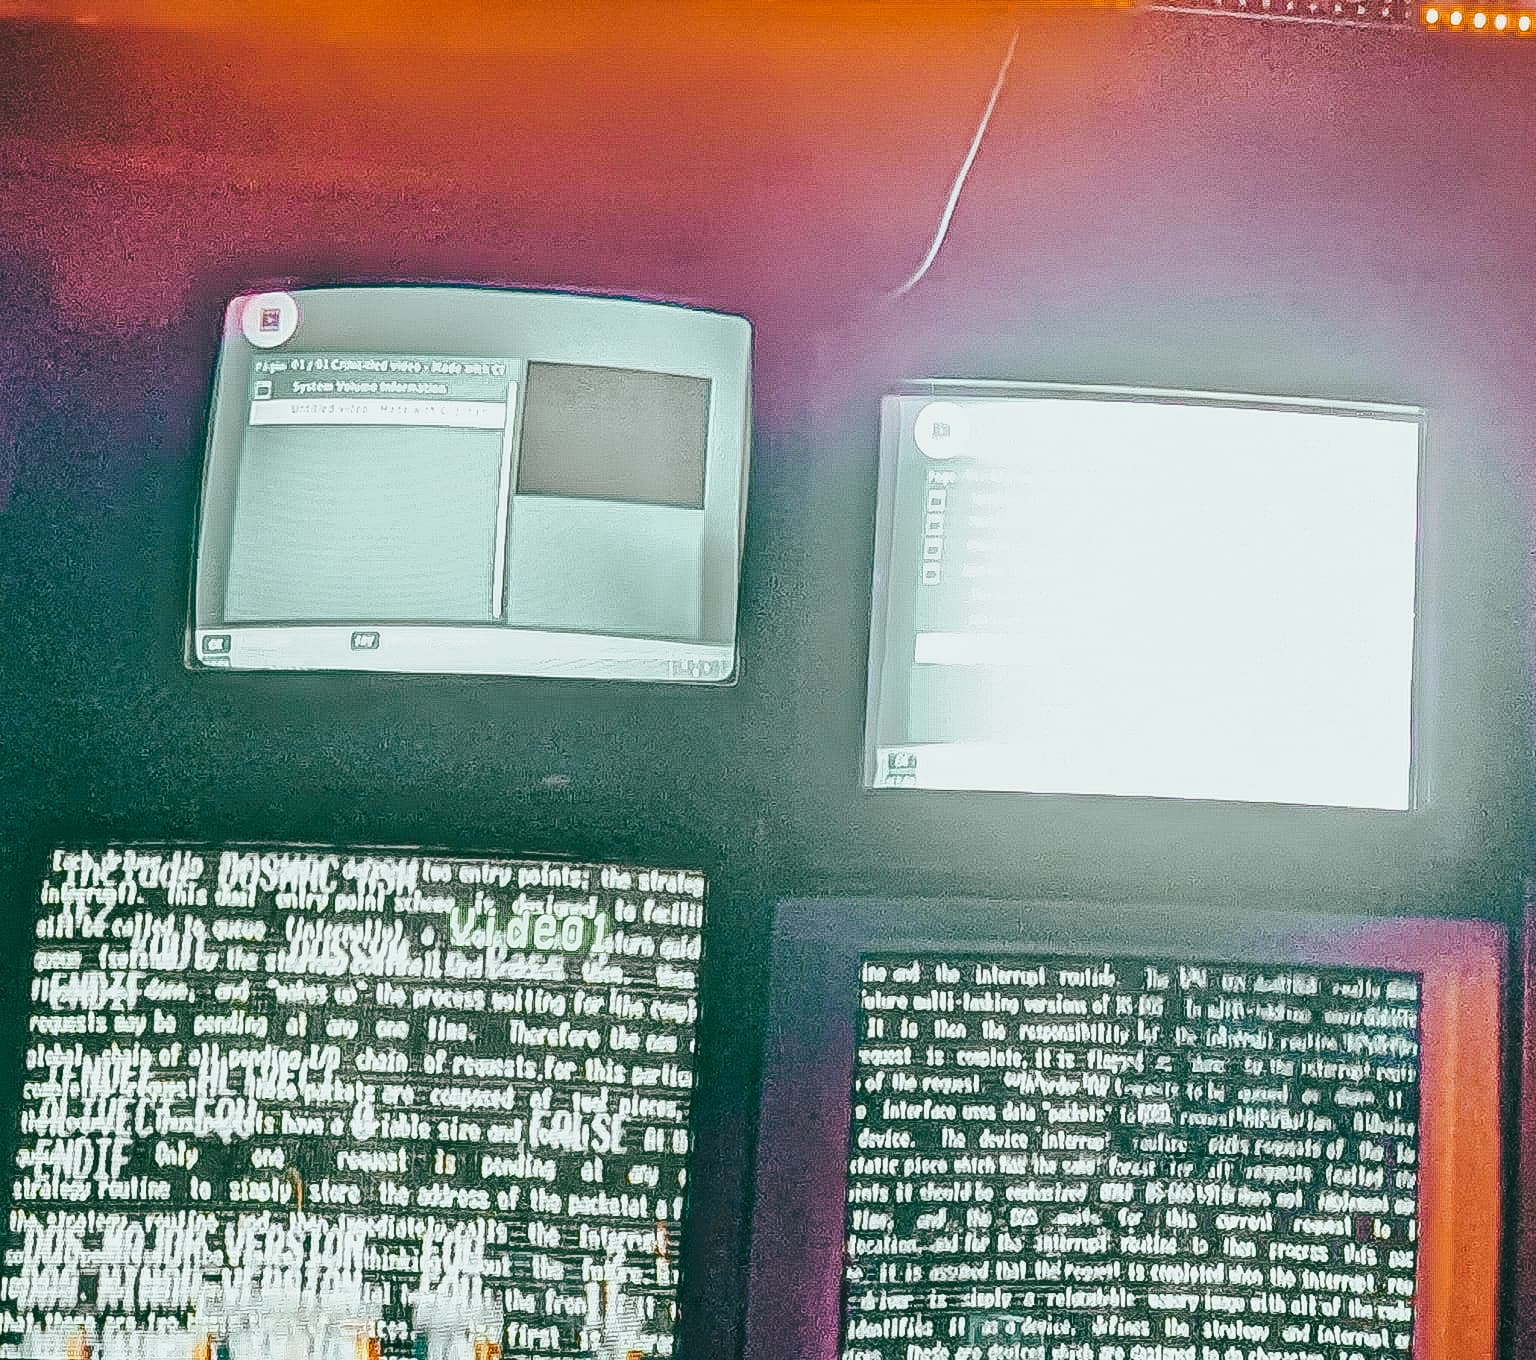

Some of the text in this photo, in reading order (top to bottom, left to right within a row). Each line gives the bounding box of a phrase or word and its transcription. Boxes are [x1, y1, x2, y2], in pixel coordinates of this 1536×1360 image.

[293, 381, 334, 394] System
[601, 866, 633, 890] the
[450, 905, 608, 953] Video1
[935, 962, 961, 984] the
[509, 1019, 600, 1051] Therefore
